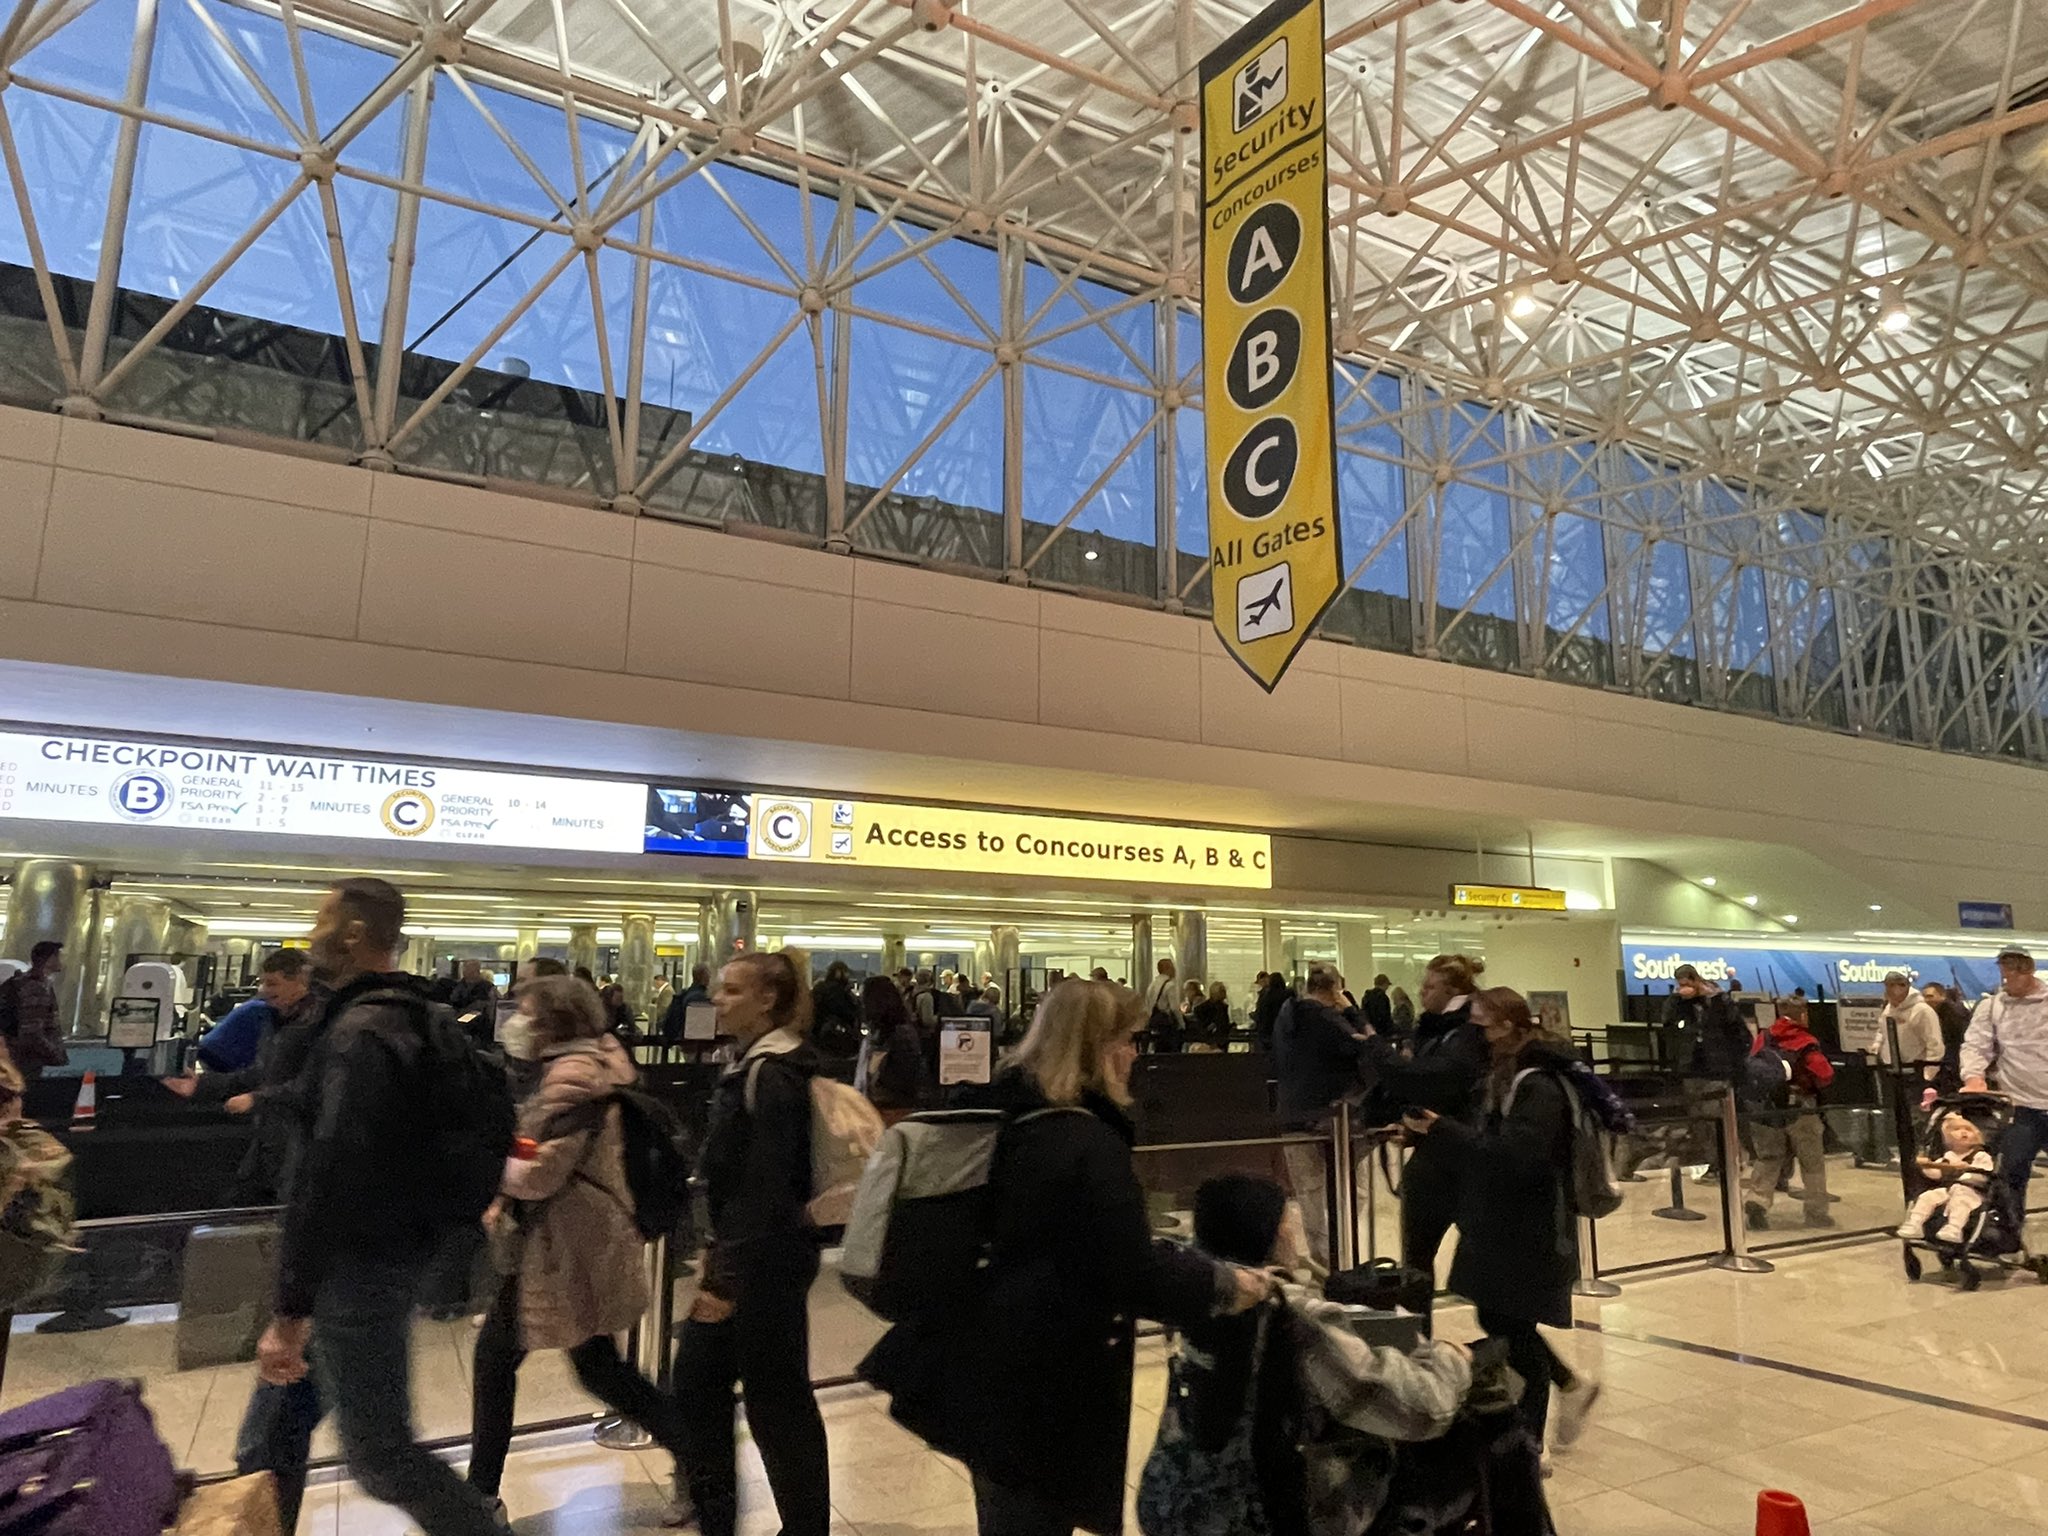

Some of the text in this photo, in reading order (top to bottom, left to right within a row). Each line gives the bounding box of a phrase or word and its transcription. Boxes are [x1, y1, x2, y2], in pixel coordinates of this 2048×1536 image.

[1213, 98, 1316, 185] Security
[1212, 150, 1320, 231] Concourses
[1240, 225, 1284, 293] A
[1247, 329, 1281, 393] B
[1244, 435, 1280, 497] C
[1213, 516, 1326, 569] All Gates
[41, 740, 436, 789] CHECKPOINT WAIT TIMES
[25, 781, 98, 797] MINUTES
[180, 787, 242, 800] PRIORITY
[182, 775, 243, 789] GENERAL
[310, 801, 371, 815] MINUTES
[440, 805, 493, 817] PRIORITY
[441, 794, 494, 806] GENERAL
[393, 800, 419, 826] C
[551, 817, 605, 830] MINUTES
[384, 821, 429, 838] CHECKPOINT
[772, 815, 794, 840] C
[865, 822, 1267, 870] Access to Concourses A, B & C
[1468, 891, 1500, 906] Security
